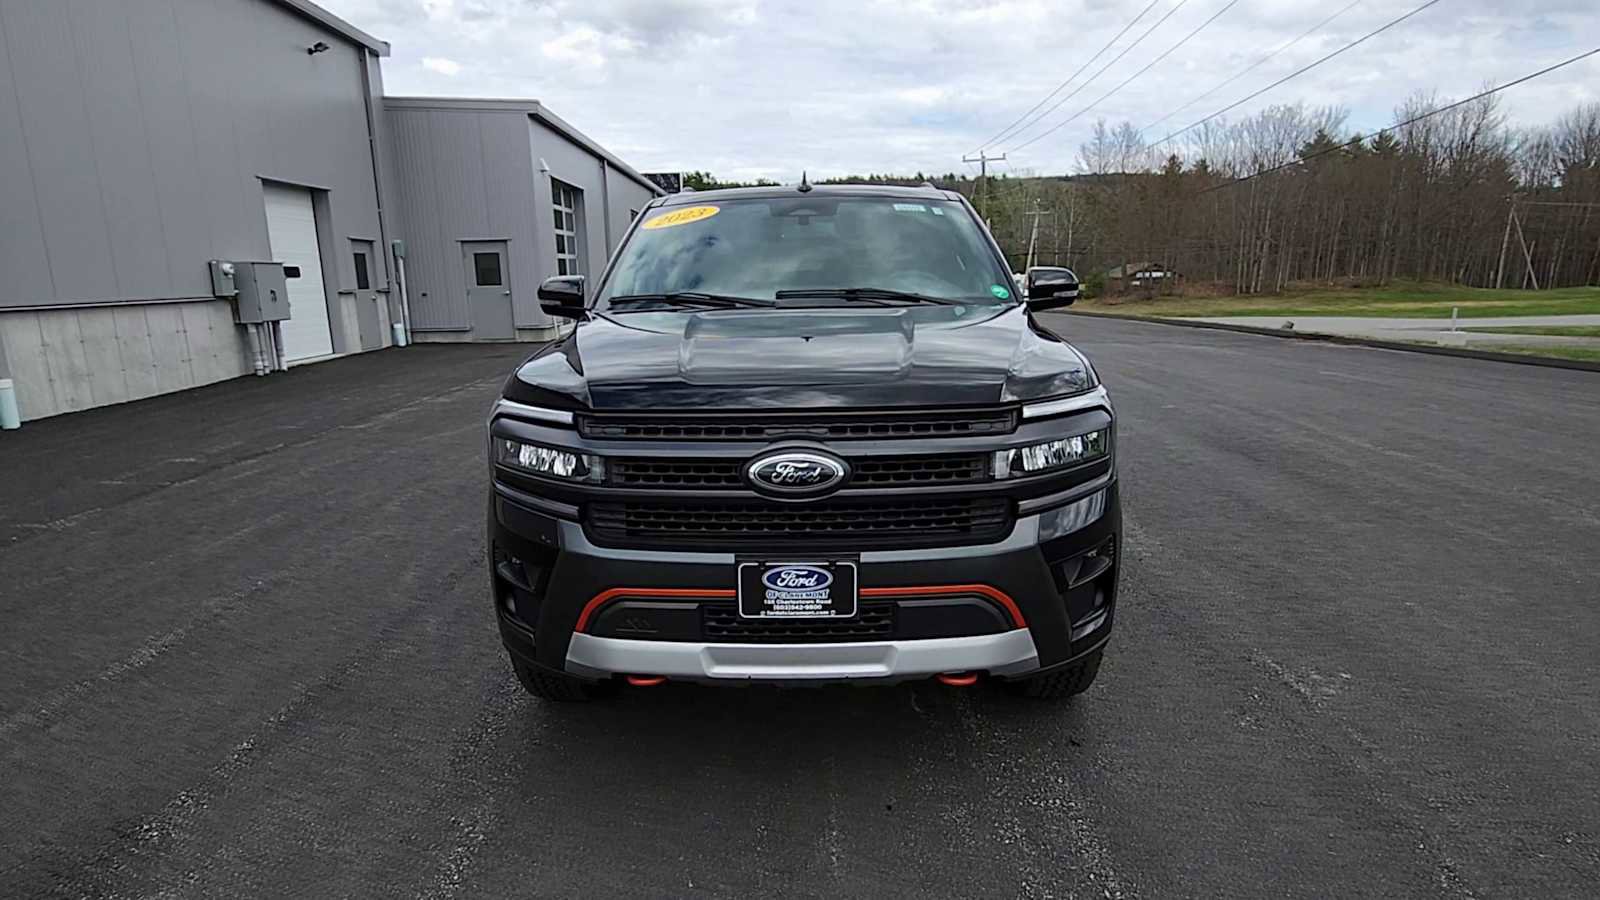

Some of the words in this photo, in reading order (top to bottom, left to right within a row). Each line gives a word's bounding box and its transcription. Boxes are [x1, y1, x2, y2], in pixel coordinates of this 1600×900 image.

[655, 207, 708, 227] 2023
[771, 462, 821, 483] Ford
[777, 570, 819, 587] Ford
[766, 589, 777, 599] OF
